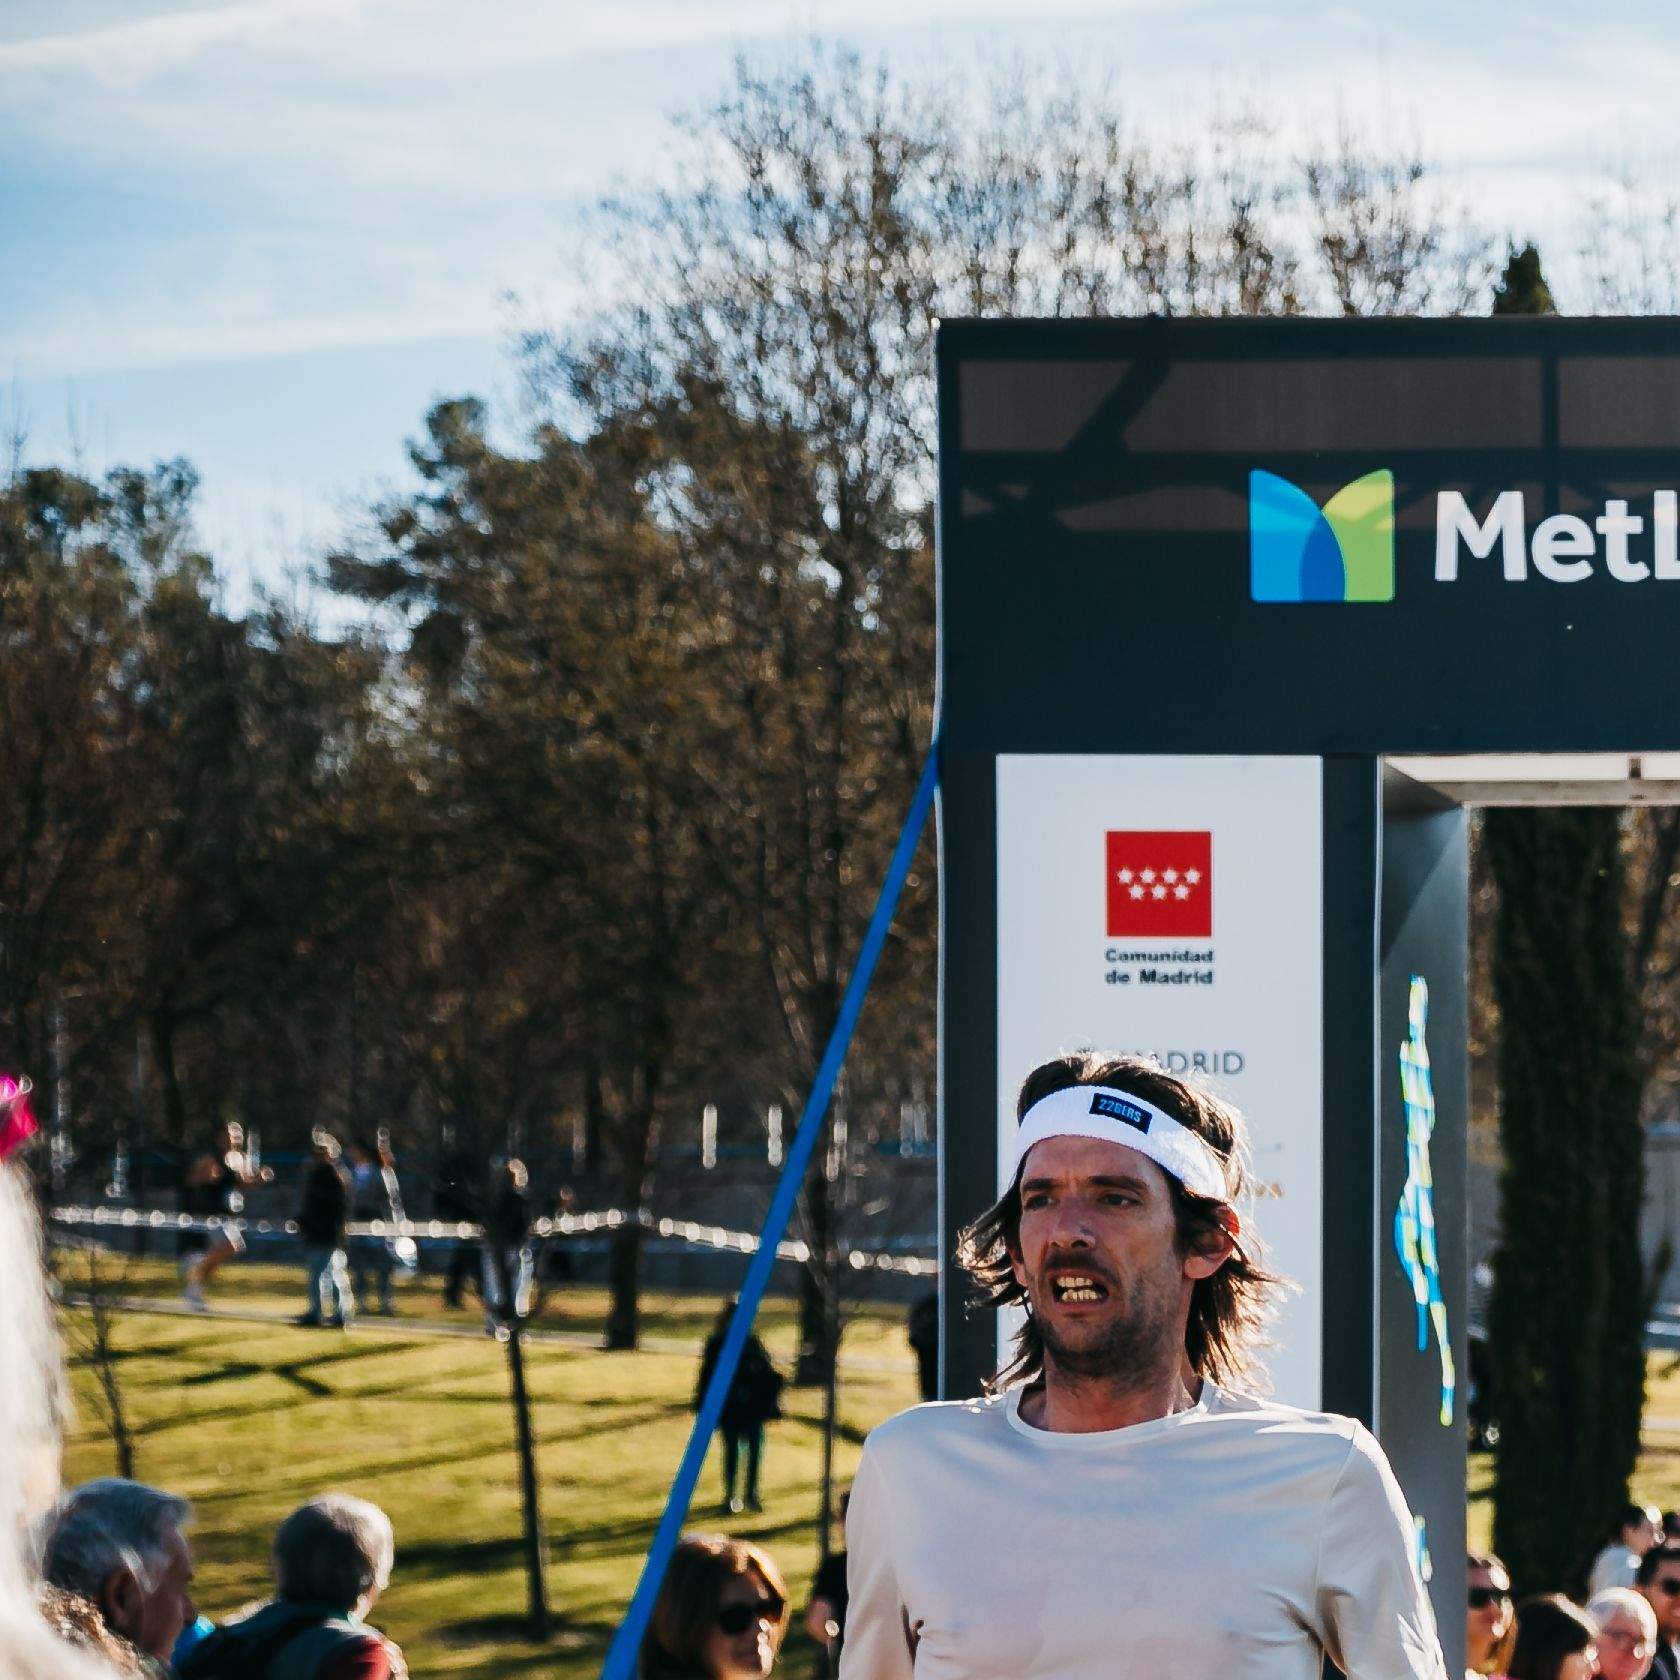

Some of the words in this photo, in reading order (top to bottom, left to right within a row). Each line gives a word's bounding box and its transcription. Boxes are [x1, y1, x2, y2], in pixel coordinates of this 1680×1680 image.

[1105, 949, 1214, 964] Comunidad
[1105, 970, 1130, 985] de
[1139, 969, 1214, 985] Madrid
